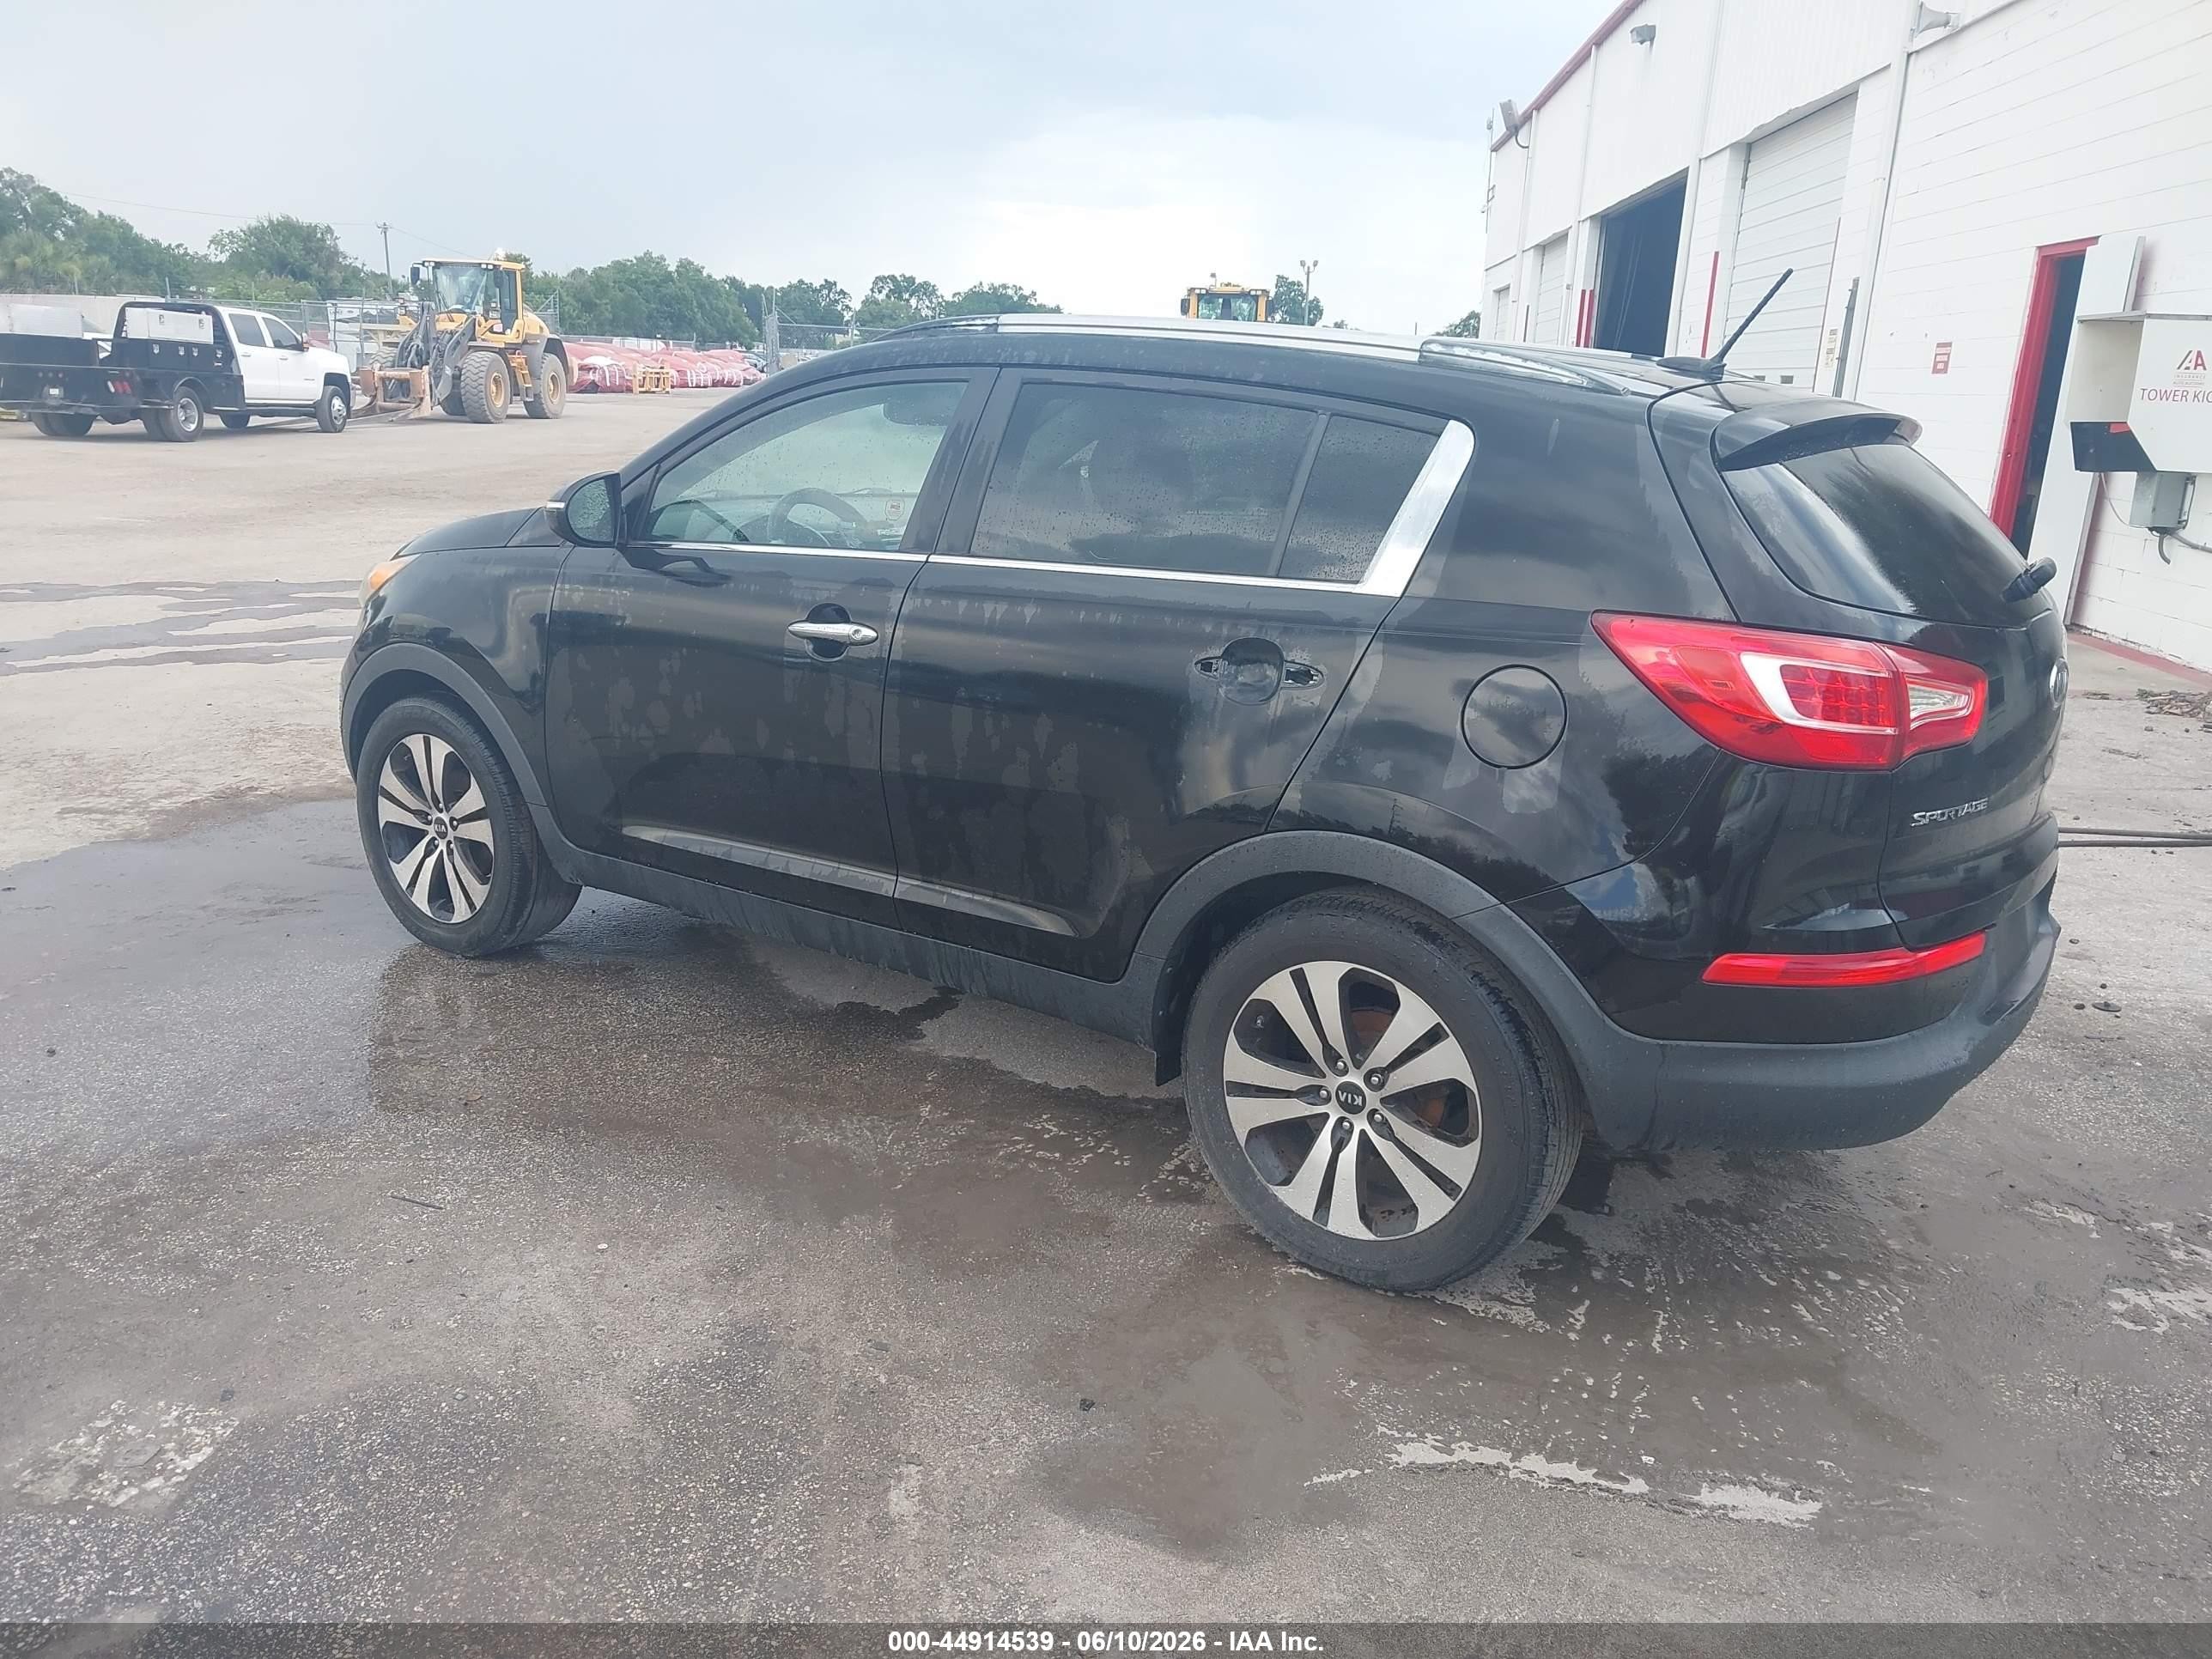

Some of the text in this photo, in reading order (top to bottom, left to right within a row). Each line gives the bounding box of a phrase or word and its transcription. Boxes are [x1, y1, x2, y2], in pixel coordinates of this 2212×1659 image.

[2140, 388, 2189, 403] TOWER
[1909, 797, 1989, 827] SPORTAGE
[434, 823, 447, 833] KIA
[1338, 1090, 1363, 1107] KIA
